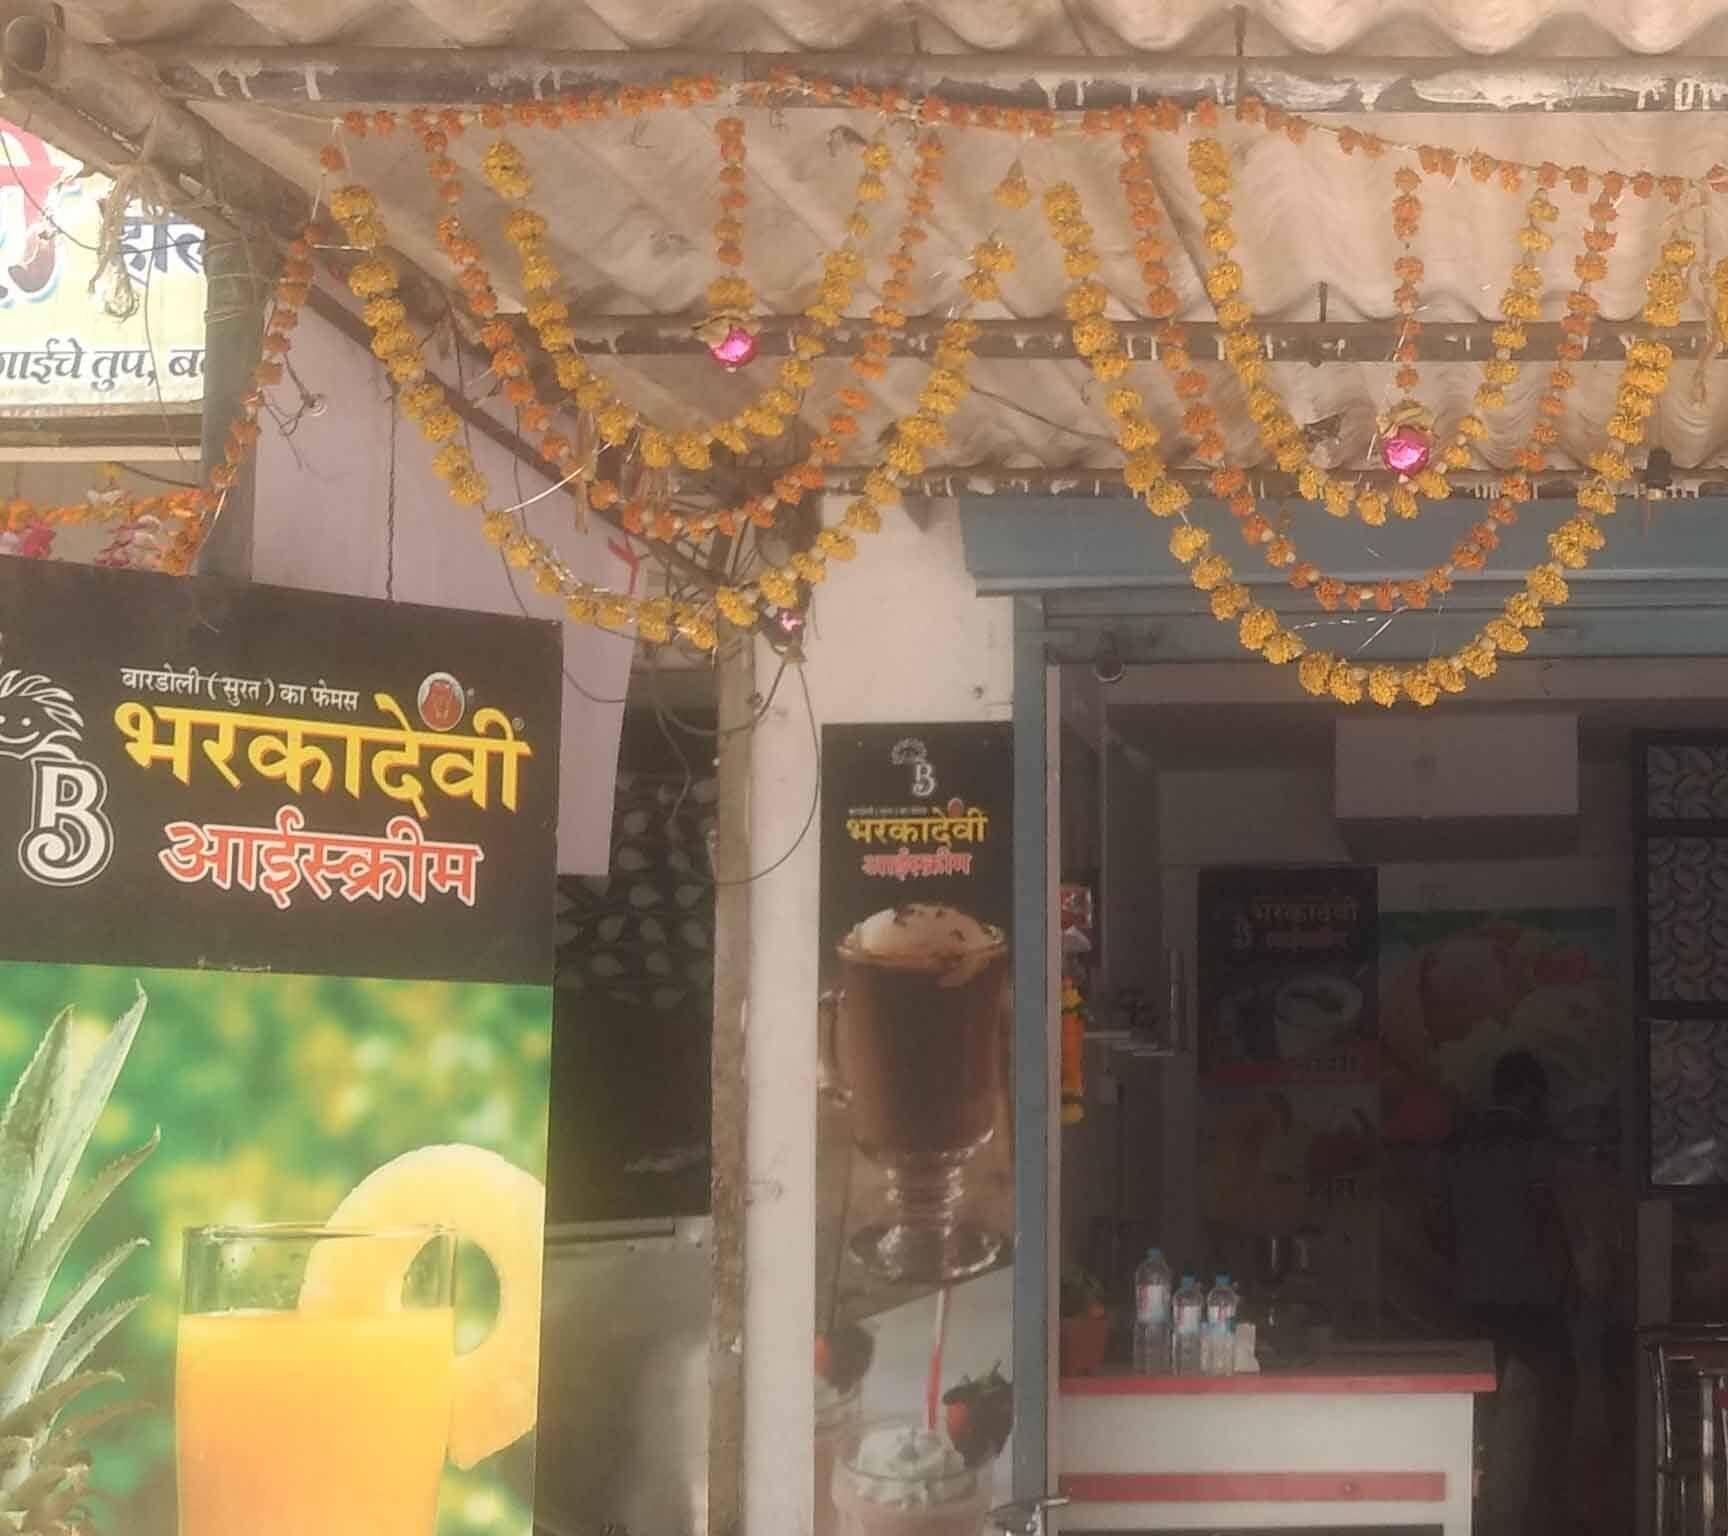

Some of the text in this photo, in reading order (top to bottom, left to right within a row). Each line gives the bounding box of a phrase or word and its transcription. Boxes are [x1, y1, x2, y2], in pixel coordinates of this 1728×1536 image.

[120, 663, 201, 696] बारडोली
[279, 682, 305, 705] का
[312, 679, 360, 712] फेमस
[113, 693, 532, 819] भरकादेवी
[158, 804, 484, 910] आईस्क्रीम
[846, 807, 989, 848] भरकादेवी
